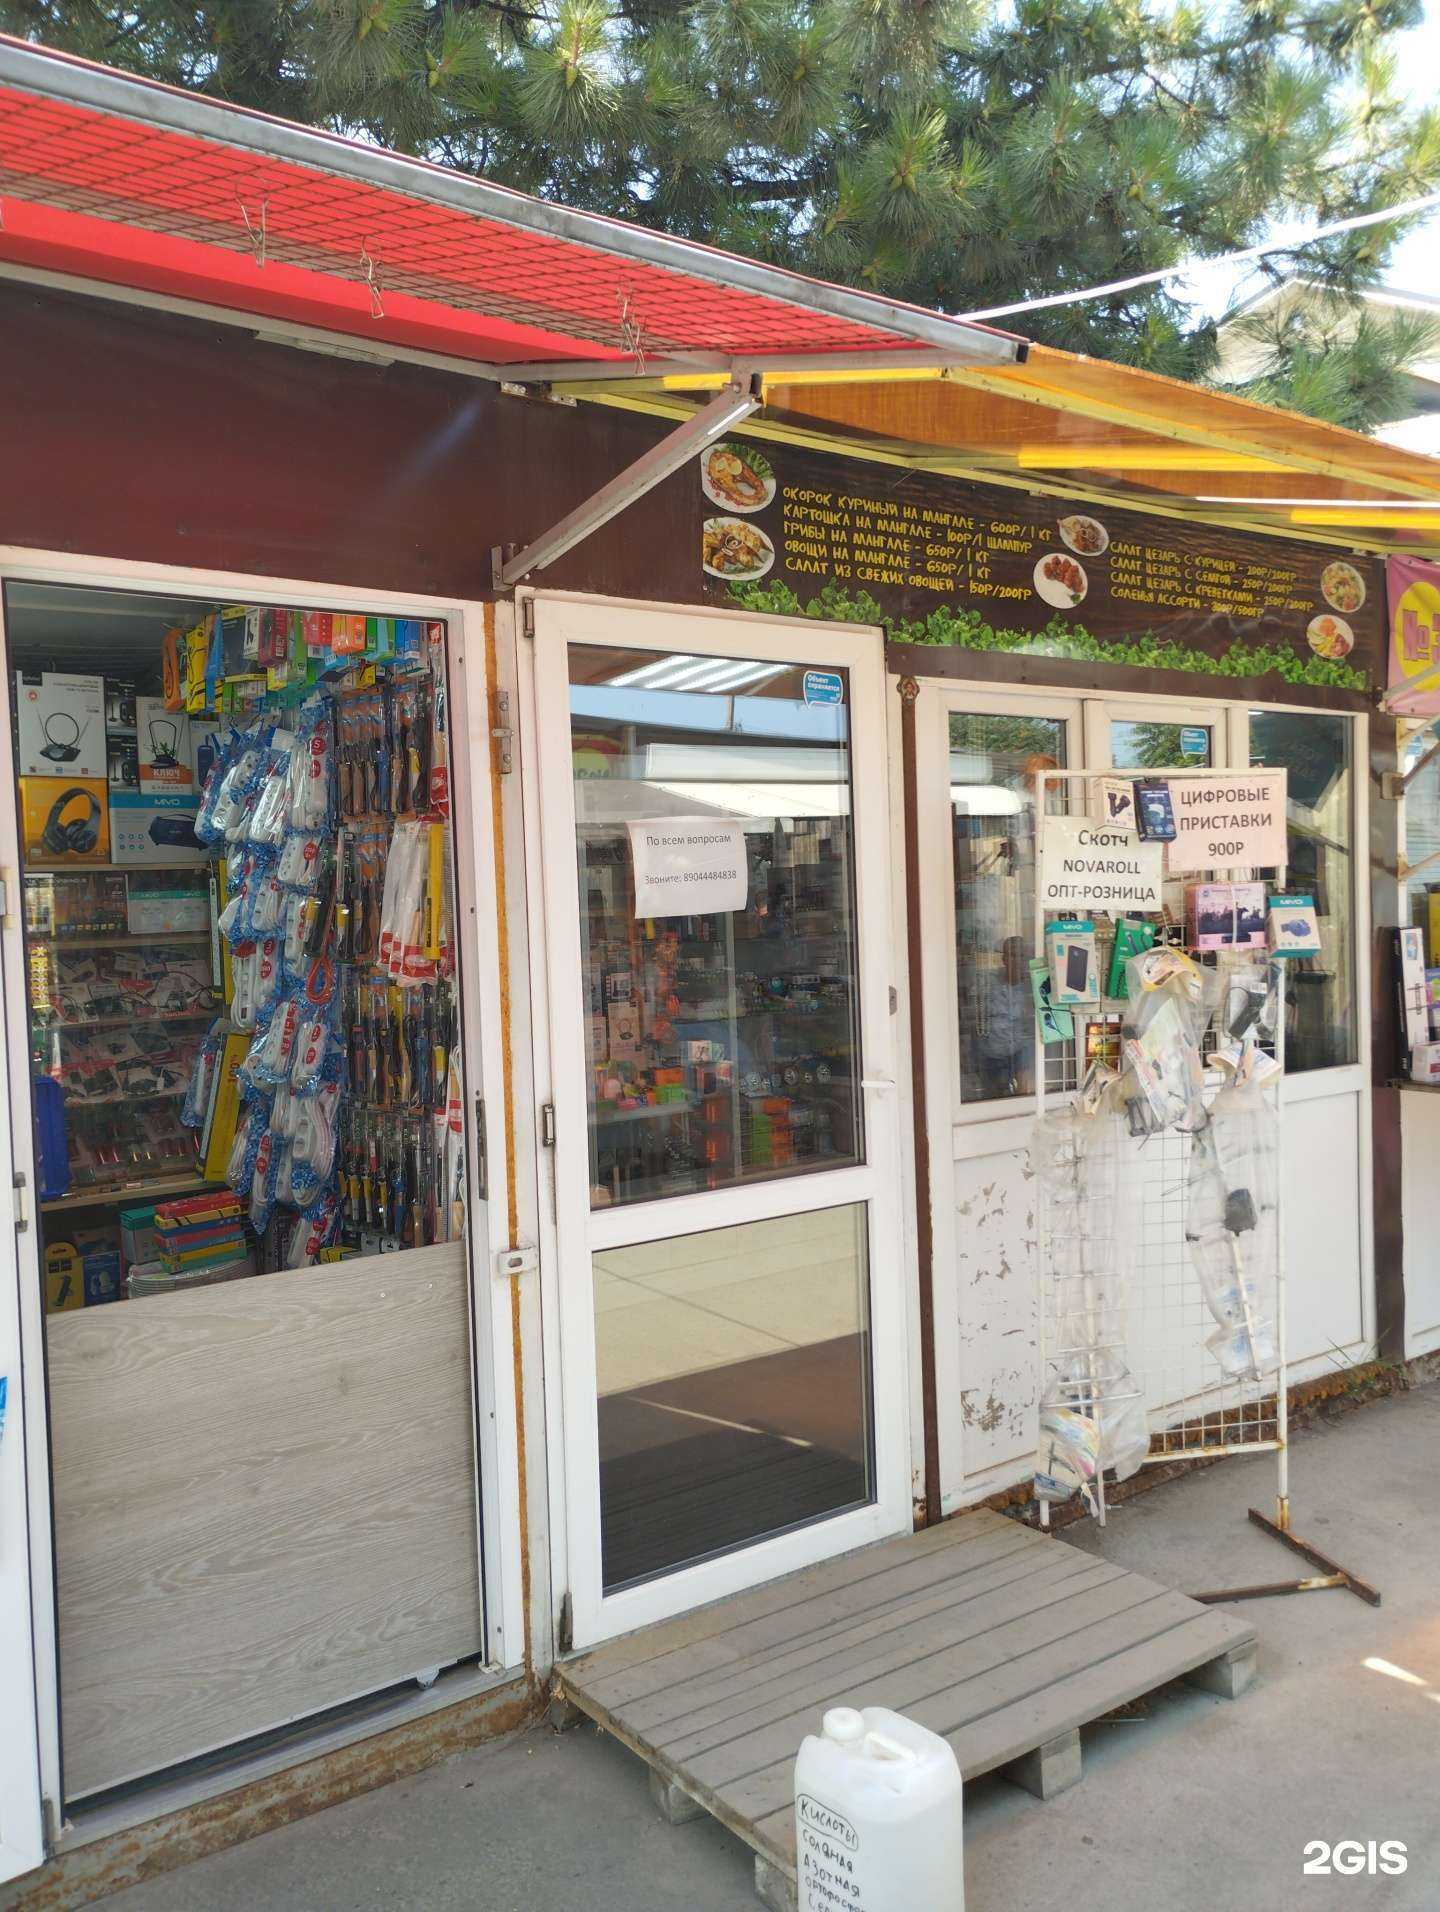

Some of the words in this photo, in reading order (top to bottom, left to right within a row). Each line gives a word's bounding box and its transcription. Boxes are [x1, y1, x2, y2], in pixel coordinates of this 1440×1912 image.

[782, 487, 832, 507] ОКОРОК
[838, 495, 898, 517] КУРИНЫЙ
[903, 506, 918, 520] НА
[922, 510, 975, 530] МАНГАЛЕ
[990, 521, 1027, 538] 600Р/
[1039, 529, 1053, 542] КГ
[783, 503, 851, 527] КАРТОШКА
[856, 515, 872, 529] НА
[877, 519, 932, 539] МАНГАЛЕ
[986, 535, 1033, 554] ШАМПУР
[783, 520, 826, 540] ГРИБЫ
[831, 529, 848, 543] НА
[853, 532, 911, 553] МАНГАЛЕ
[925, 543, 962, 560] 650Р/
[975, 550, 990, 563] КГ
[784, 540, 828, 559] ОВОЩИ
[833, 547, 850, 561] НА
[854, 550, 911, 570] МАНГАЛЕ
[926, 560, 964, 577] 650Р/
[977, 567, 992, 579] КГ
[1109, 541, 1142, 557] САЛАТ
[1145, 547, 1181, 564] ЦЕЗАРЬ
[1183, 553, 1193, 566] С
[785, 557, 829, 576] САЛАТ
[834, 563, 852, 578] ИЗ
[857, 567, 904, 585] СВЕЖИХ
[908, 574, 954, 592] ОВОЩЕЙ
[1110, 556, 1142, 571] САЛАТ
[1145, 562, 1182, 578] ЦЕЗАРЬ
[1184, 568, 1193, 580] С
[1110, 571, 1142, 586] САЛАТ
[1146, 577, 1182, 593] ЦЕЗАРЬ
[1184, 583, 1193, 594] С
[1157, 592, 1201, 610] АССОРТИ
[1180, 787, 1270, 806] ЦИФРОВЫЕ
[1179, 813, 1272, 832] ПРИСТАВКИ
[646, 836, 660, 846] По
[662, 836, 685, 846] всем
[687, 834, 732, 846] вопросам
[1078, 830, 1129, 848] Скотч
[1207, 842, 1245, 857] 900Р
[645, 874, 682, 885] Звоните:
[683, 870, 737, 883] 89044484838
[1063, 859, 1142, 874] NOVAROLL
[1047, 885, 1156, 901] ОПТ-РОЗНИЦА
[801, 1799, 856, 1846] КИСЛОТЫ
[803, 1853, 860, 1898] АЗОТНАЯ
